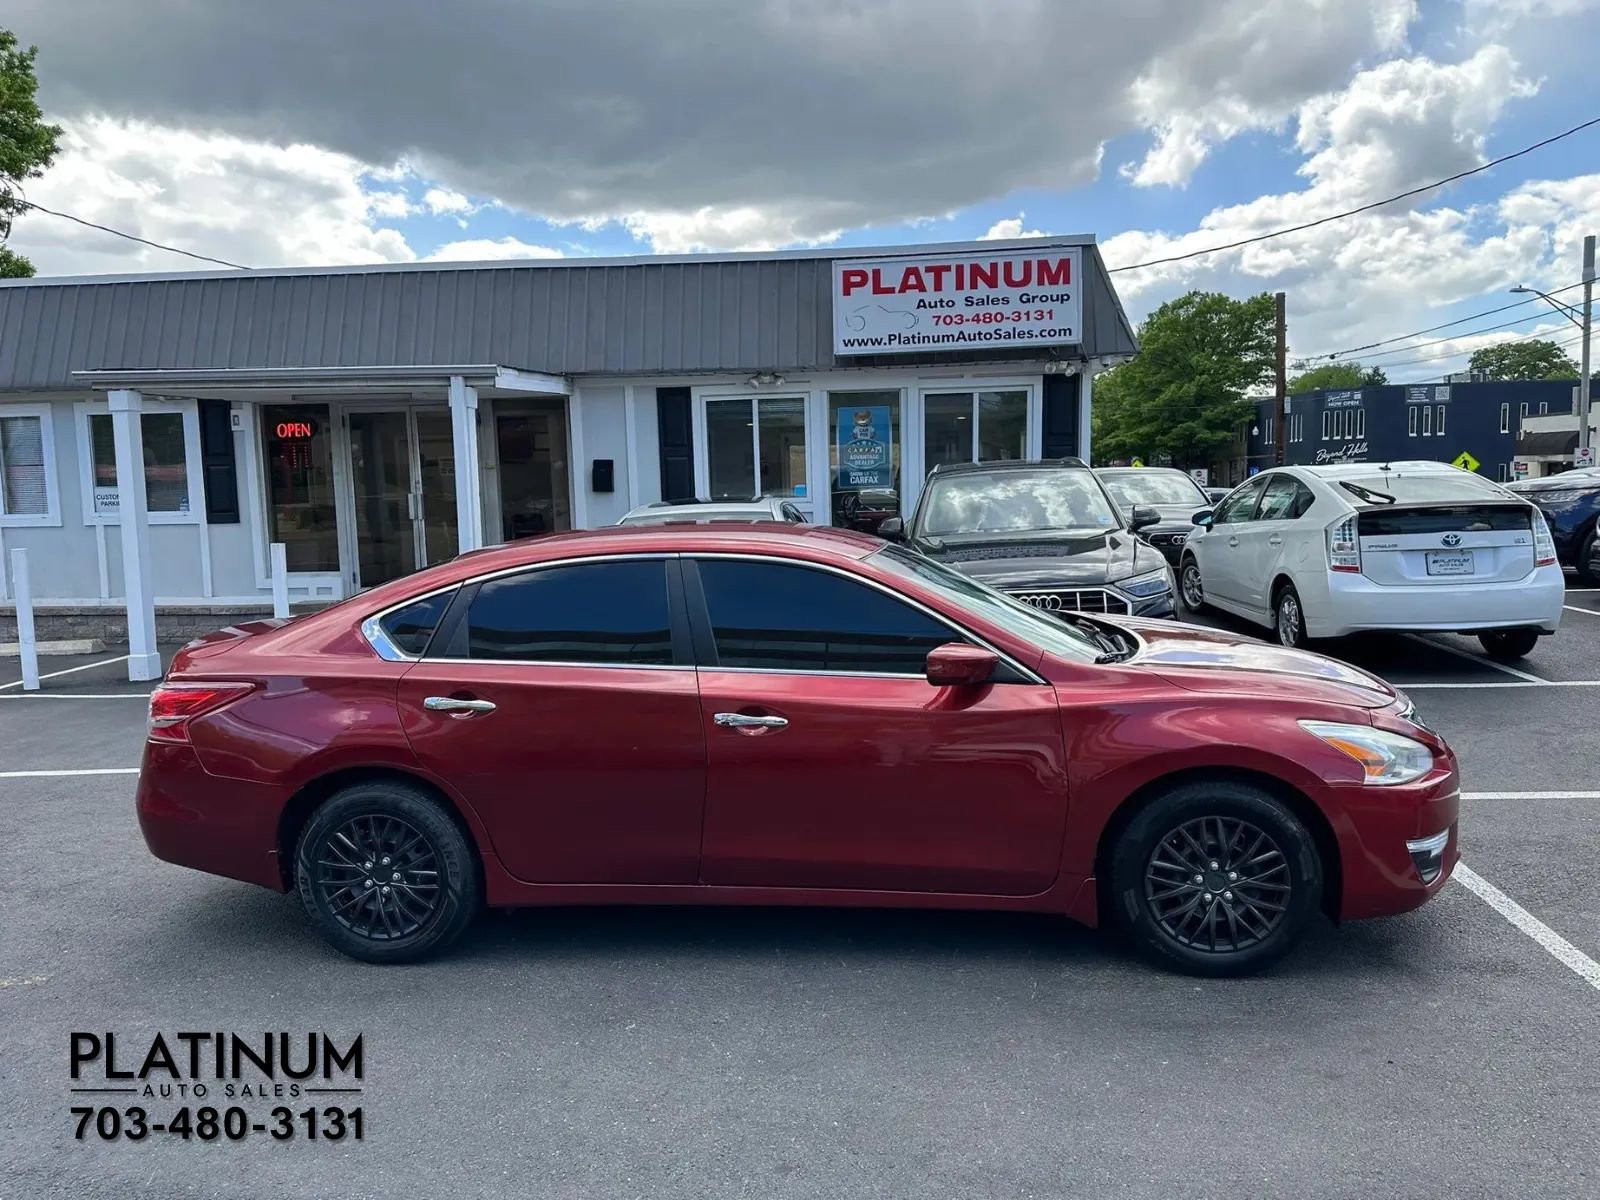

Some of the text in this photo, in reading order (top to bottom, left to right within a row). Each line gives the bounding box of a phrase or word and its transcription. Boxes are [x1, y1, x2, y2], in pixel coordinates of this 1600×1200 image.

[842, 258, 1071, 297] PLATINUM
[916, 292, 1071, 311] Auto Sales Group
[932, 309, 1054, 326] 703-480-3131
[843, 326, 1073, 348] www.PlatinumAutoSales.com
[276, 422, 311, 438] OPEN
[1316, 445, 1347, 462] Beyond
[850, 476, 879, 484] CARFAX
